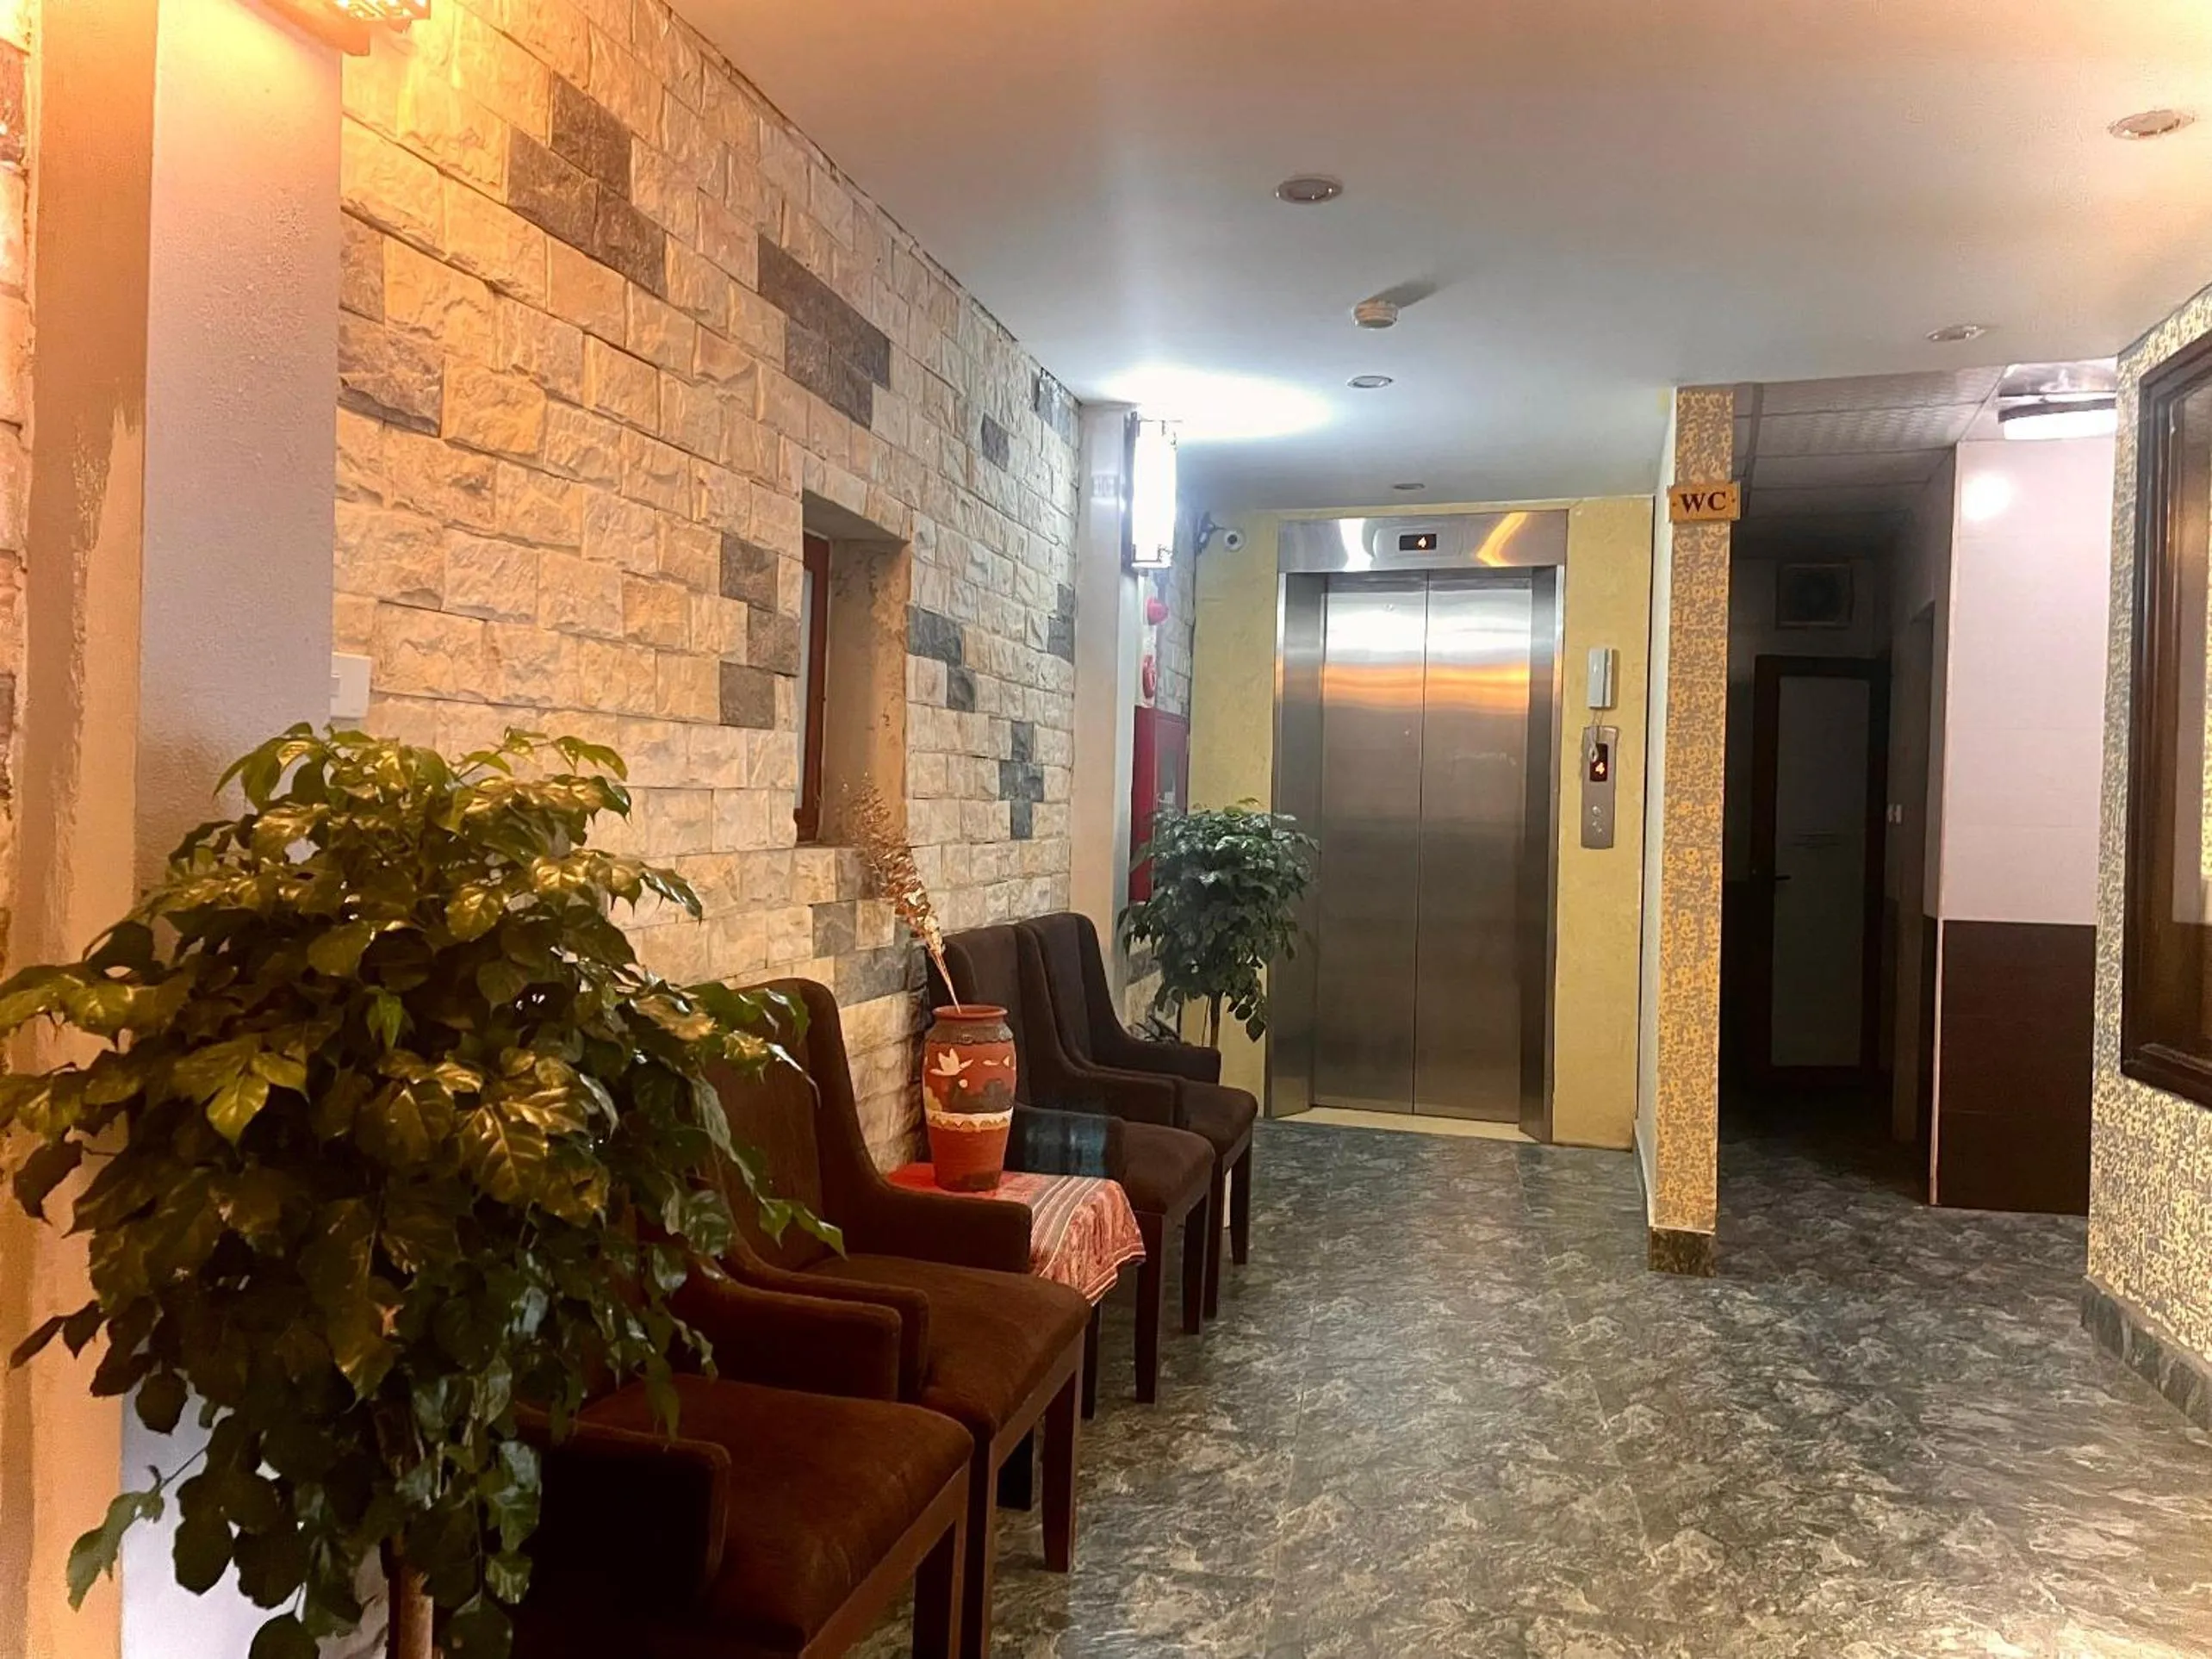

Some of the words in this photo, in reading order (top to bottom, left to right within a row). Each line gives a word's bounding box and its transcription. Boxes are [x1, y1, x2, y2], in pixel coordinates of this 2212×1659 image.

[1679, 491, 1726, 513] WC
[1417, 536, 1427, 548] 4
[1594, 761, 1606, 775] 4
